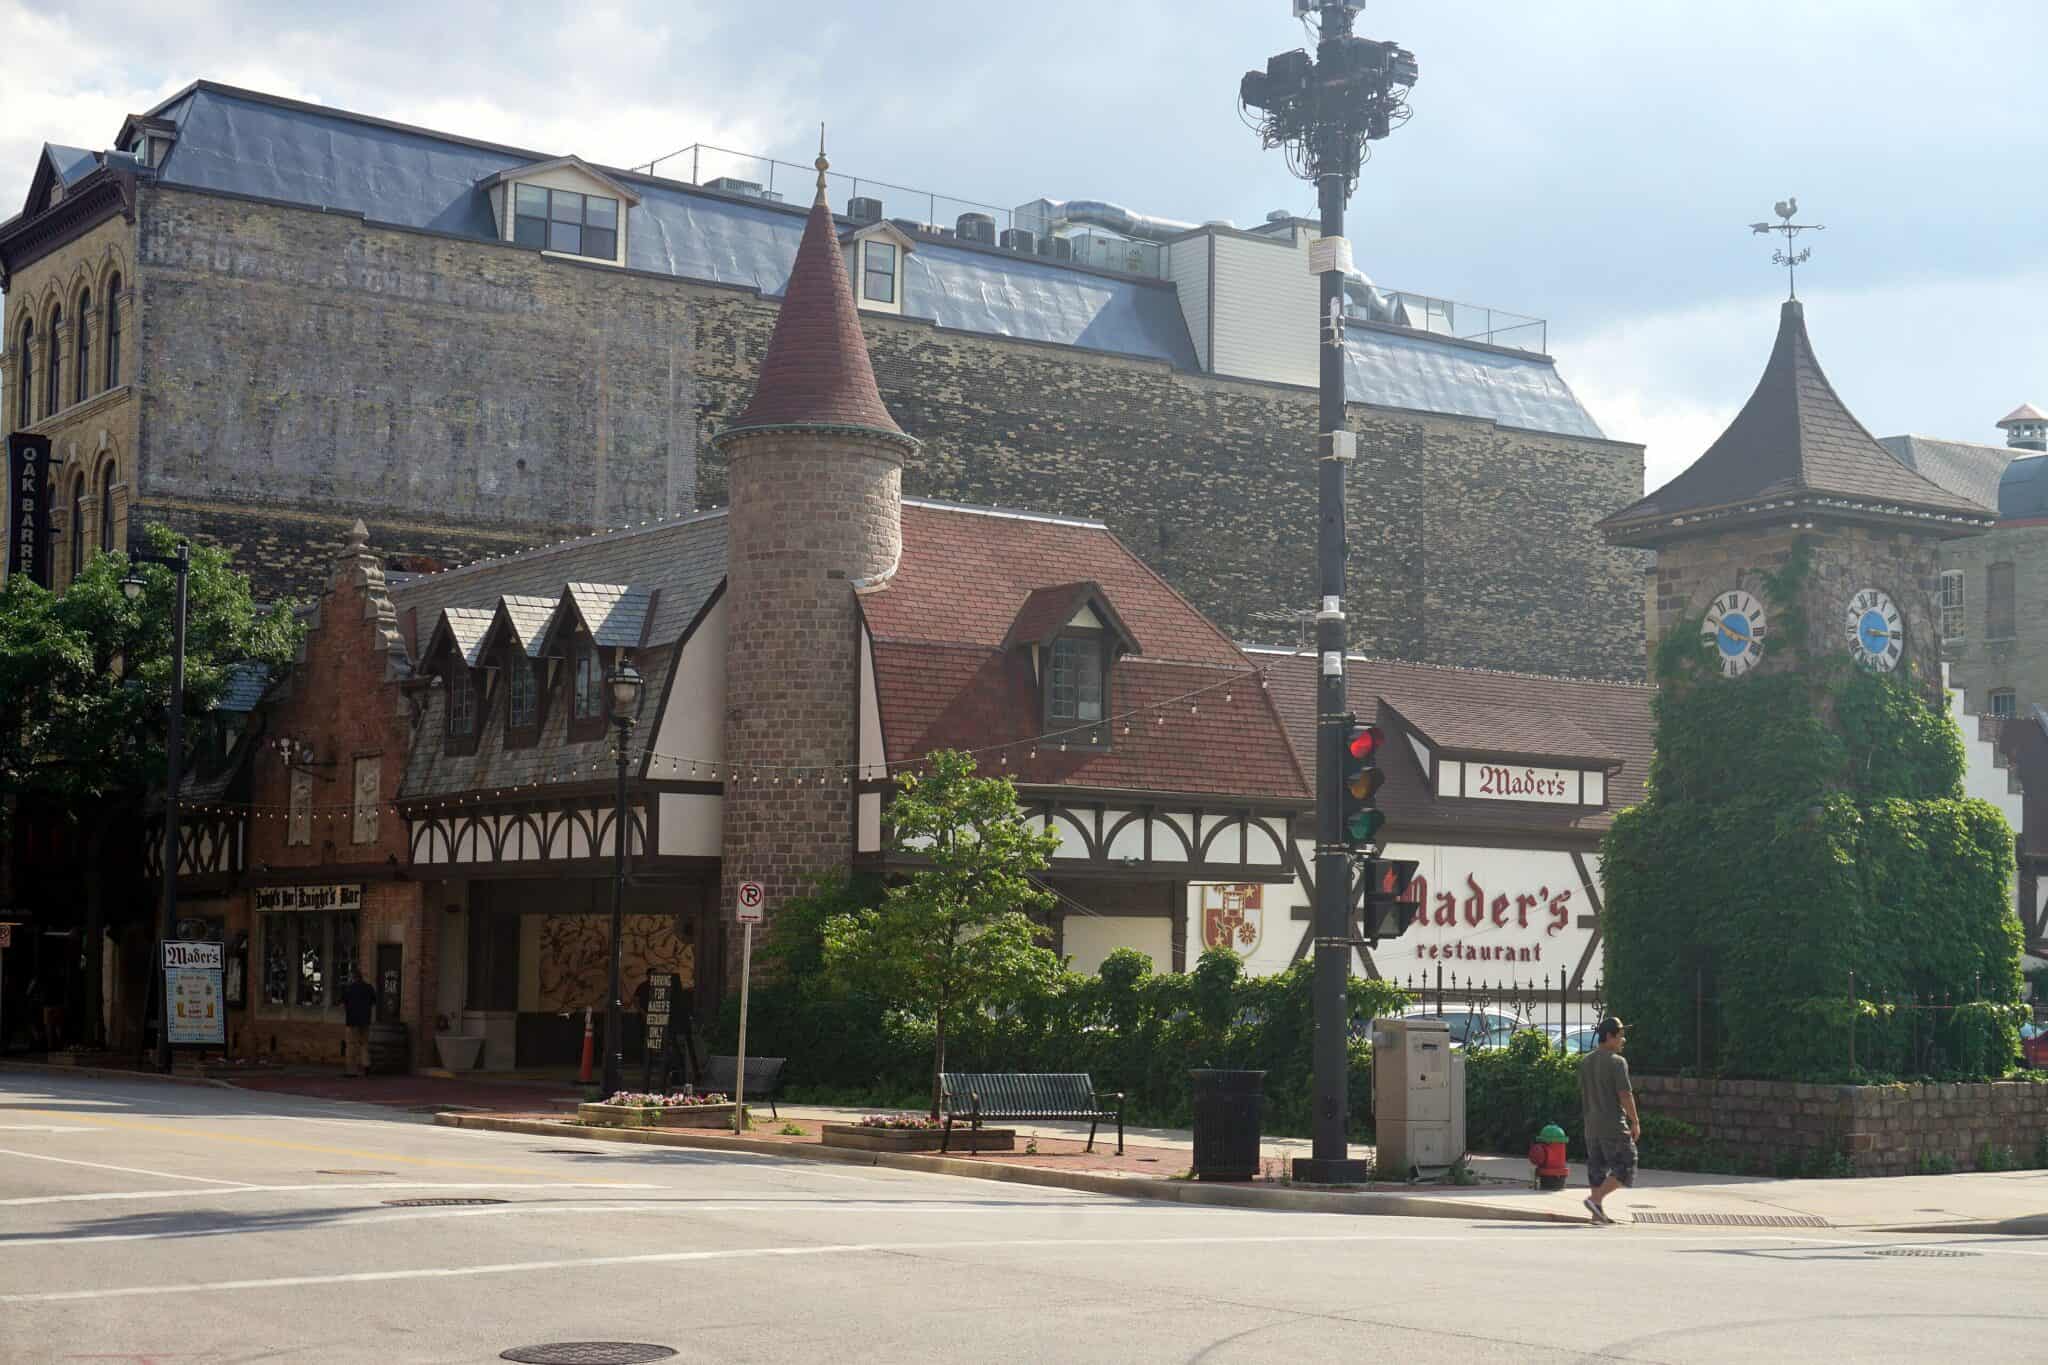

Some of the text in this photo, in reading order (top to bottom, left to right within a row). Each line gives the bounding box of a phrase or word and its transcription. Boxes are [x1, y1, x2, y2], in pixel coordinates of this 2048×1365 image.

[20, 447, 36, 573] OAK BARRE
[1479, 765, 1566, 796] Mader's
[298, 887, 360, 909] Knight's Bar
[167, 946, 219, 965] Mader's
[1416, 941, 1541, 962] restaurant
